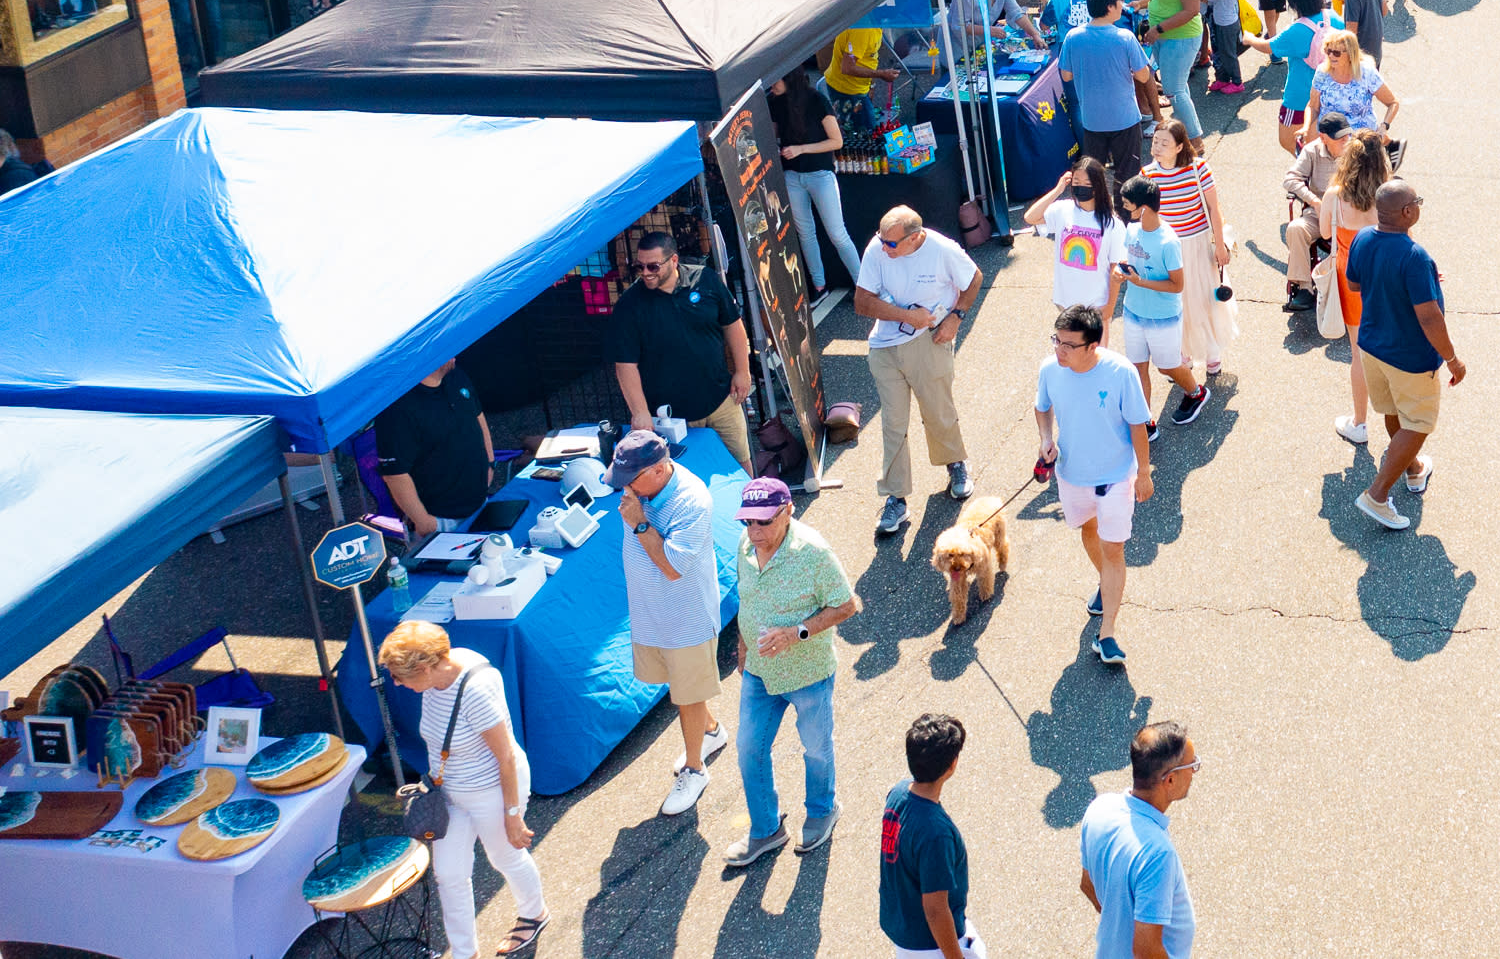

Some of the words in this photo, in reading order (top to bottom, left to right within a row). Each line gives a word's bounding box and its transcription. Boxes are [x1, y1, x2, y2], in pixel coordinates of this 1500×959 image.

[1067, 143, 1080, 161] FREE
[1077, 230, 1101, 240] CLEVER
[328, 535, 369, 566] ADT
[321, 560, 355, 576] CUSTOM
[356, 552, 380, 563] HOME
